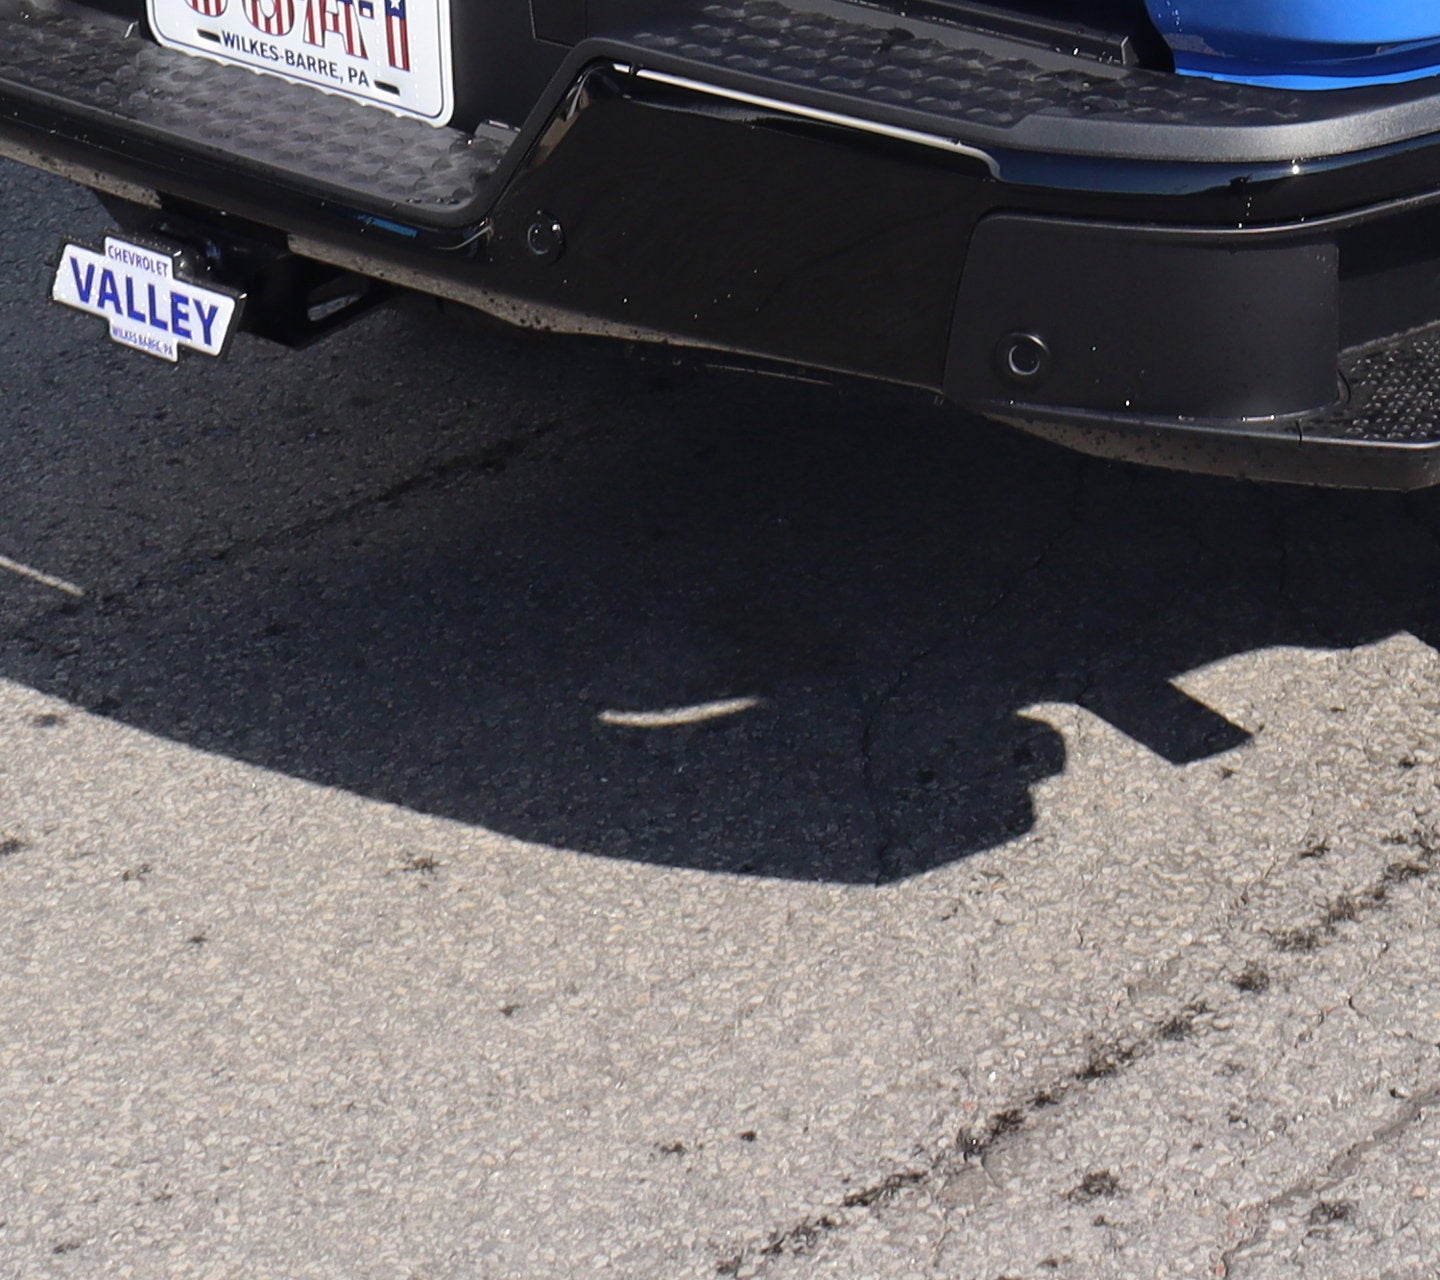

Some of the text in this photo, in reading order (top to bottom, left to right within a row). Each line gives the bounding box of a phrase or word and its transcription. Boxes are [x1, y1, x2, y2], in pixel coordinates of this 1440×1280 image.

[221, 29, 370, 88] WILKES-BARRE, PA
[107, 244, 169, 278] CHEVROLET
[69, 255, 219, 347] VALLEY
